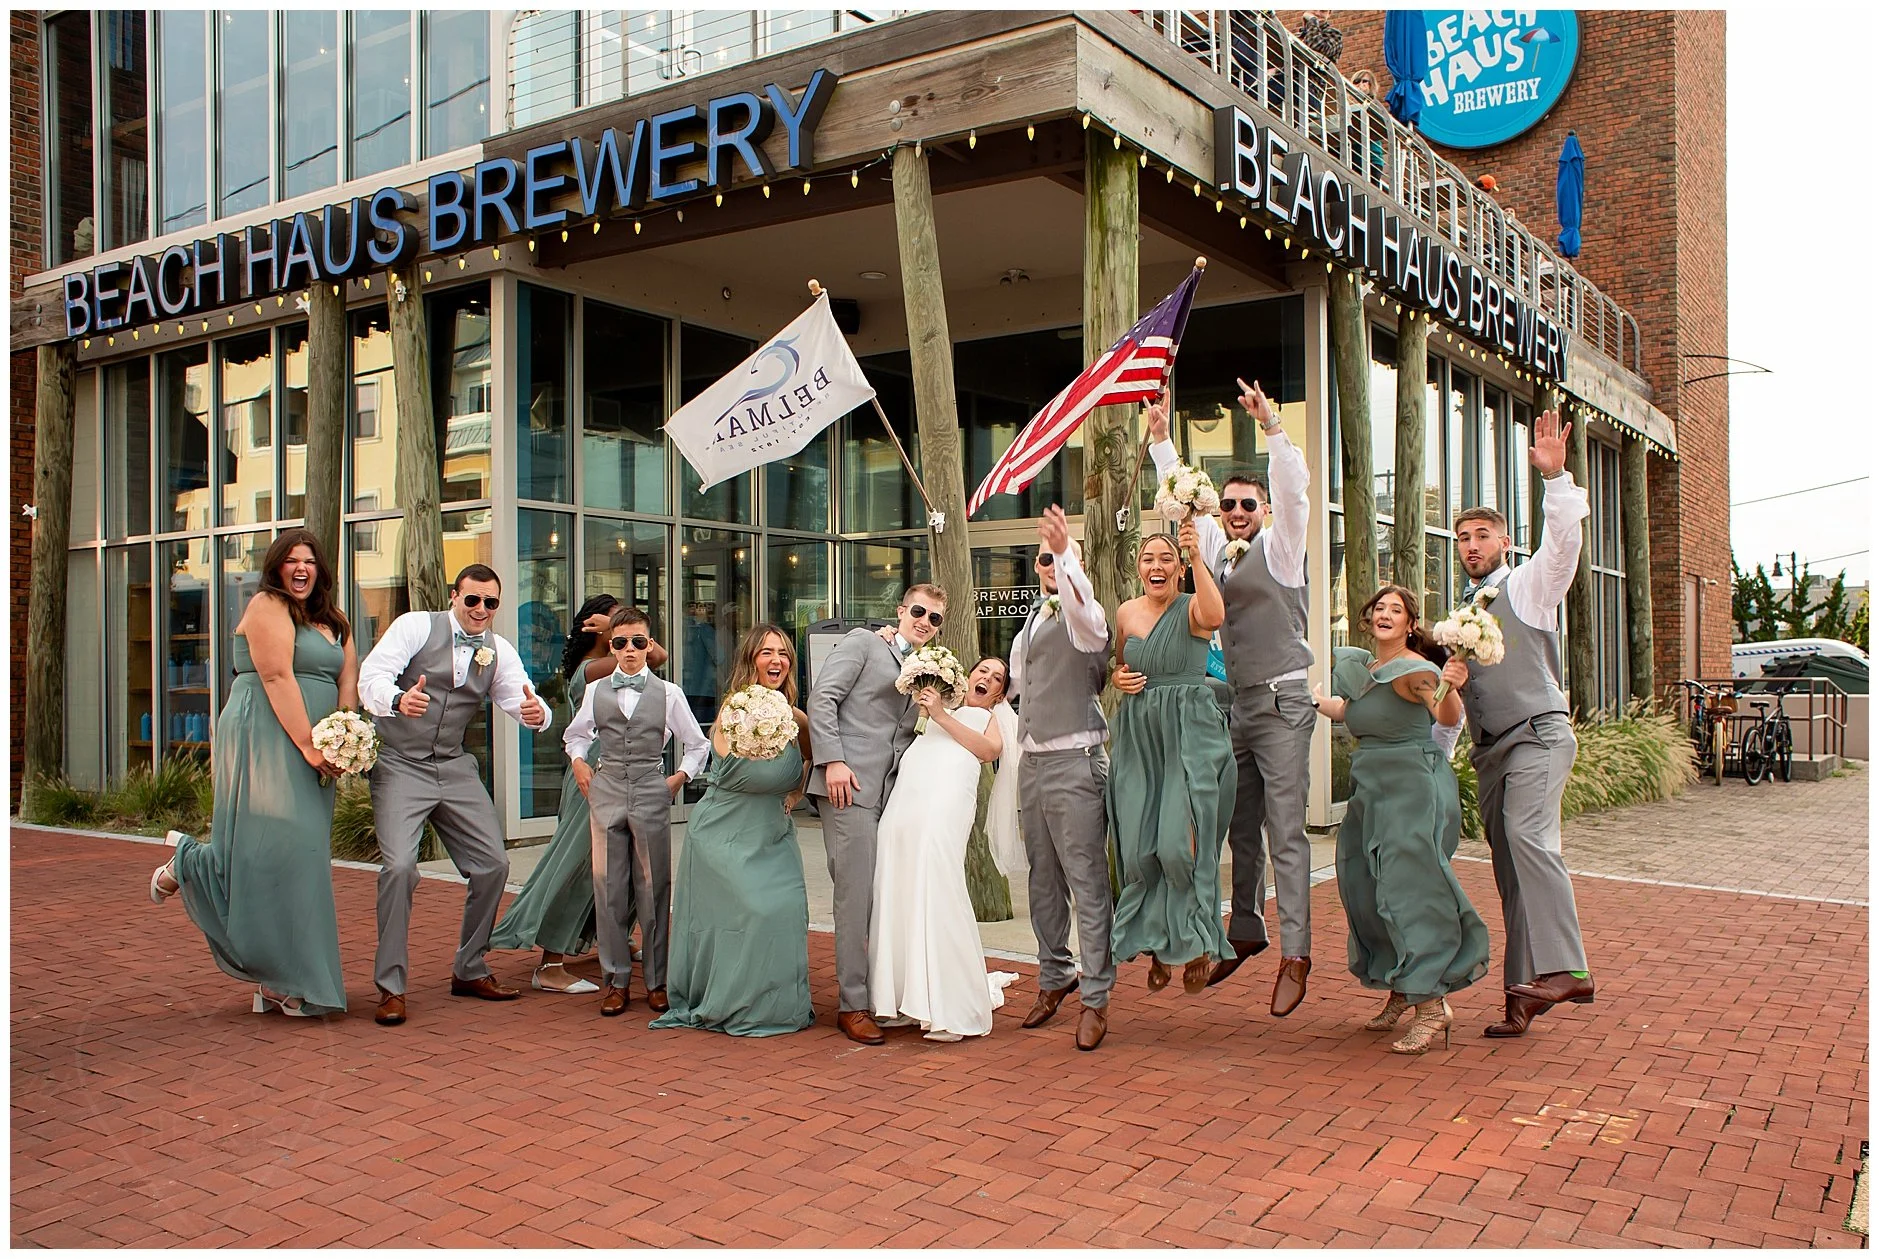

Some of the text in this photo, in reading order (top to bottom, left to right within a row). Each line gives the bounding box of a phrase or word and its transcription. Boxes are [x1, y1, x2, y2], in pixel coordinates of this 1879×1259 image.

[1419, 28, 1525, 107] HAUS
[1453, 77, 1541, 115] BREWERY
[63, 68, 832, 338] BEACH HAUS BREWERY
[1231, 104, 1571, 383] BEACH HAUS BREWERY
[973, 589, 1039, 602] BREWERY
[975, 604, 1034, 616] AP ROO
